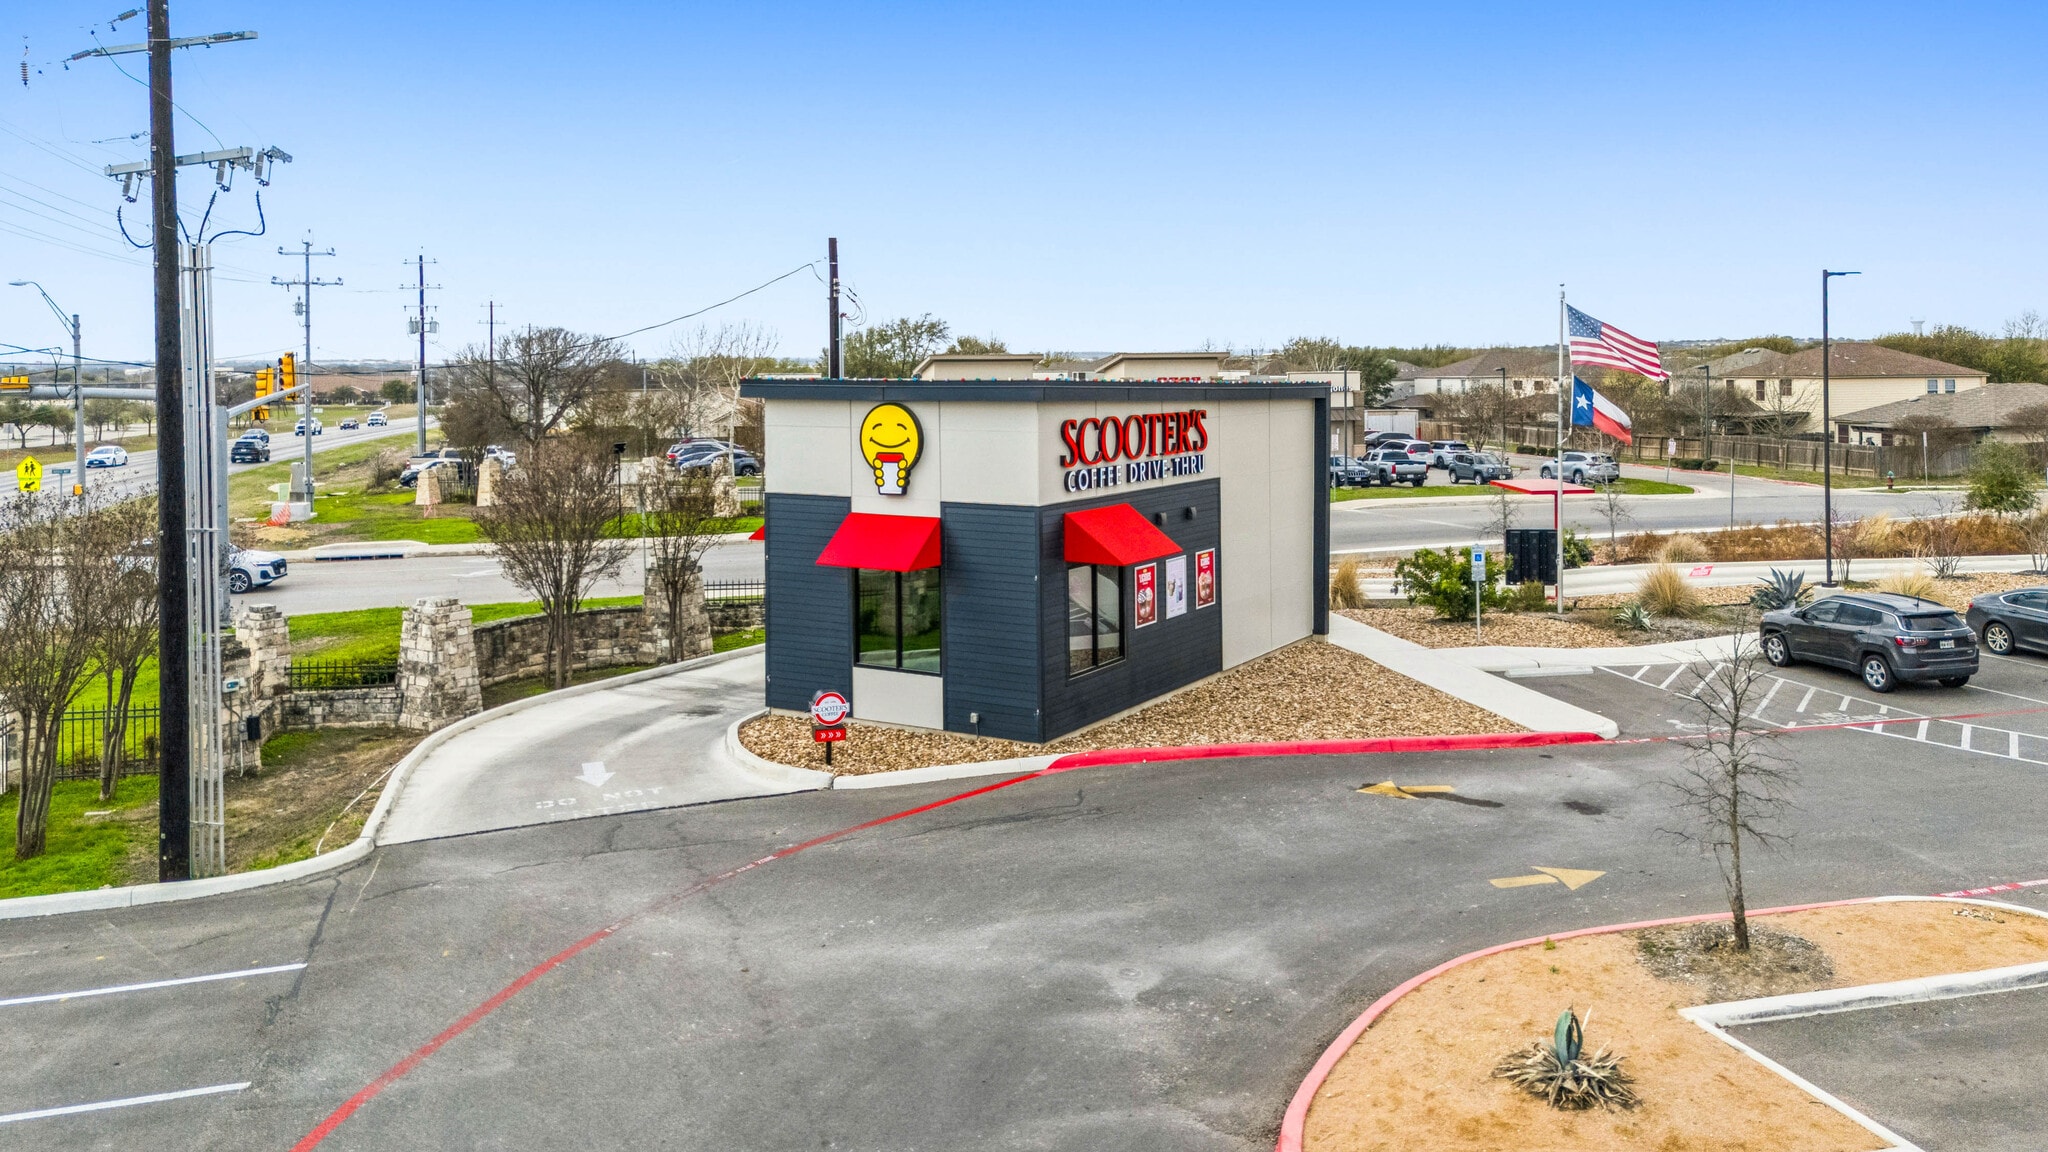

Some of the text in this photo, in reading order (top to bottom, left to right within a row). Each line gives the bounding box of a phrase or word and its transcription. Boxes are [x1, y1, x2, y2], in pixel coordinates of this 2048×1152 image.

[1060, 409, 1208, 468] SCOOTER'S
[1064, 465, 1122, 492] COFFEE
[602, 787, 663, 801] NOT
